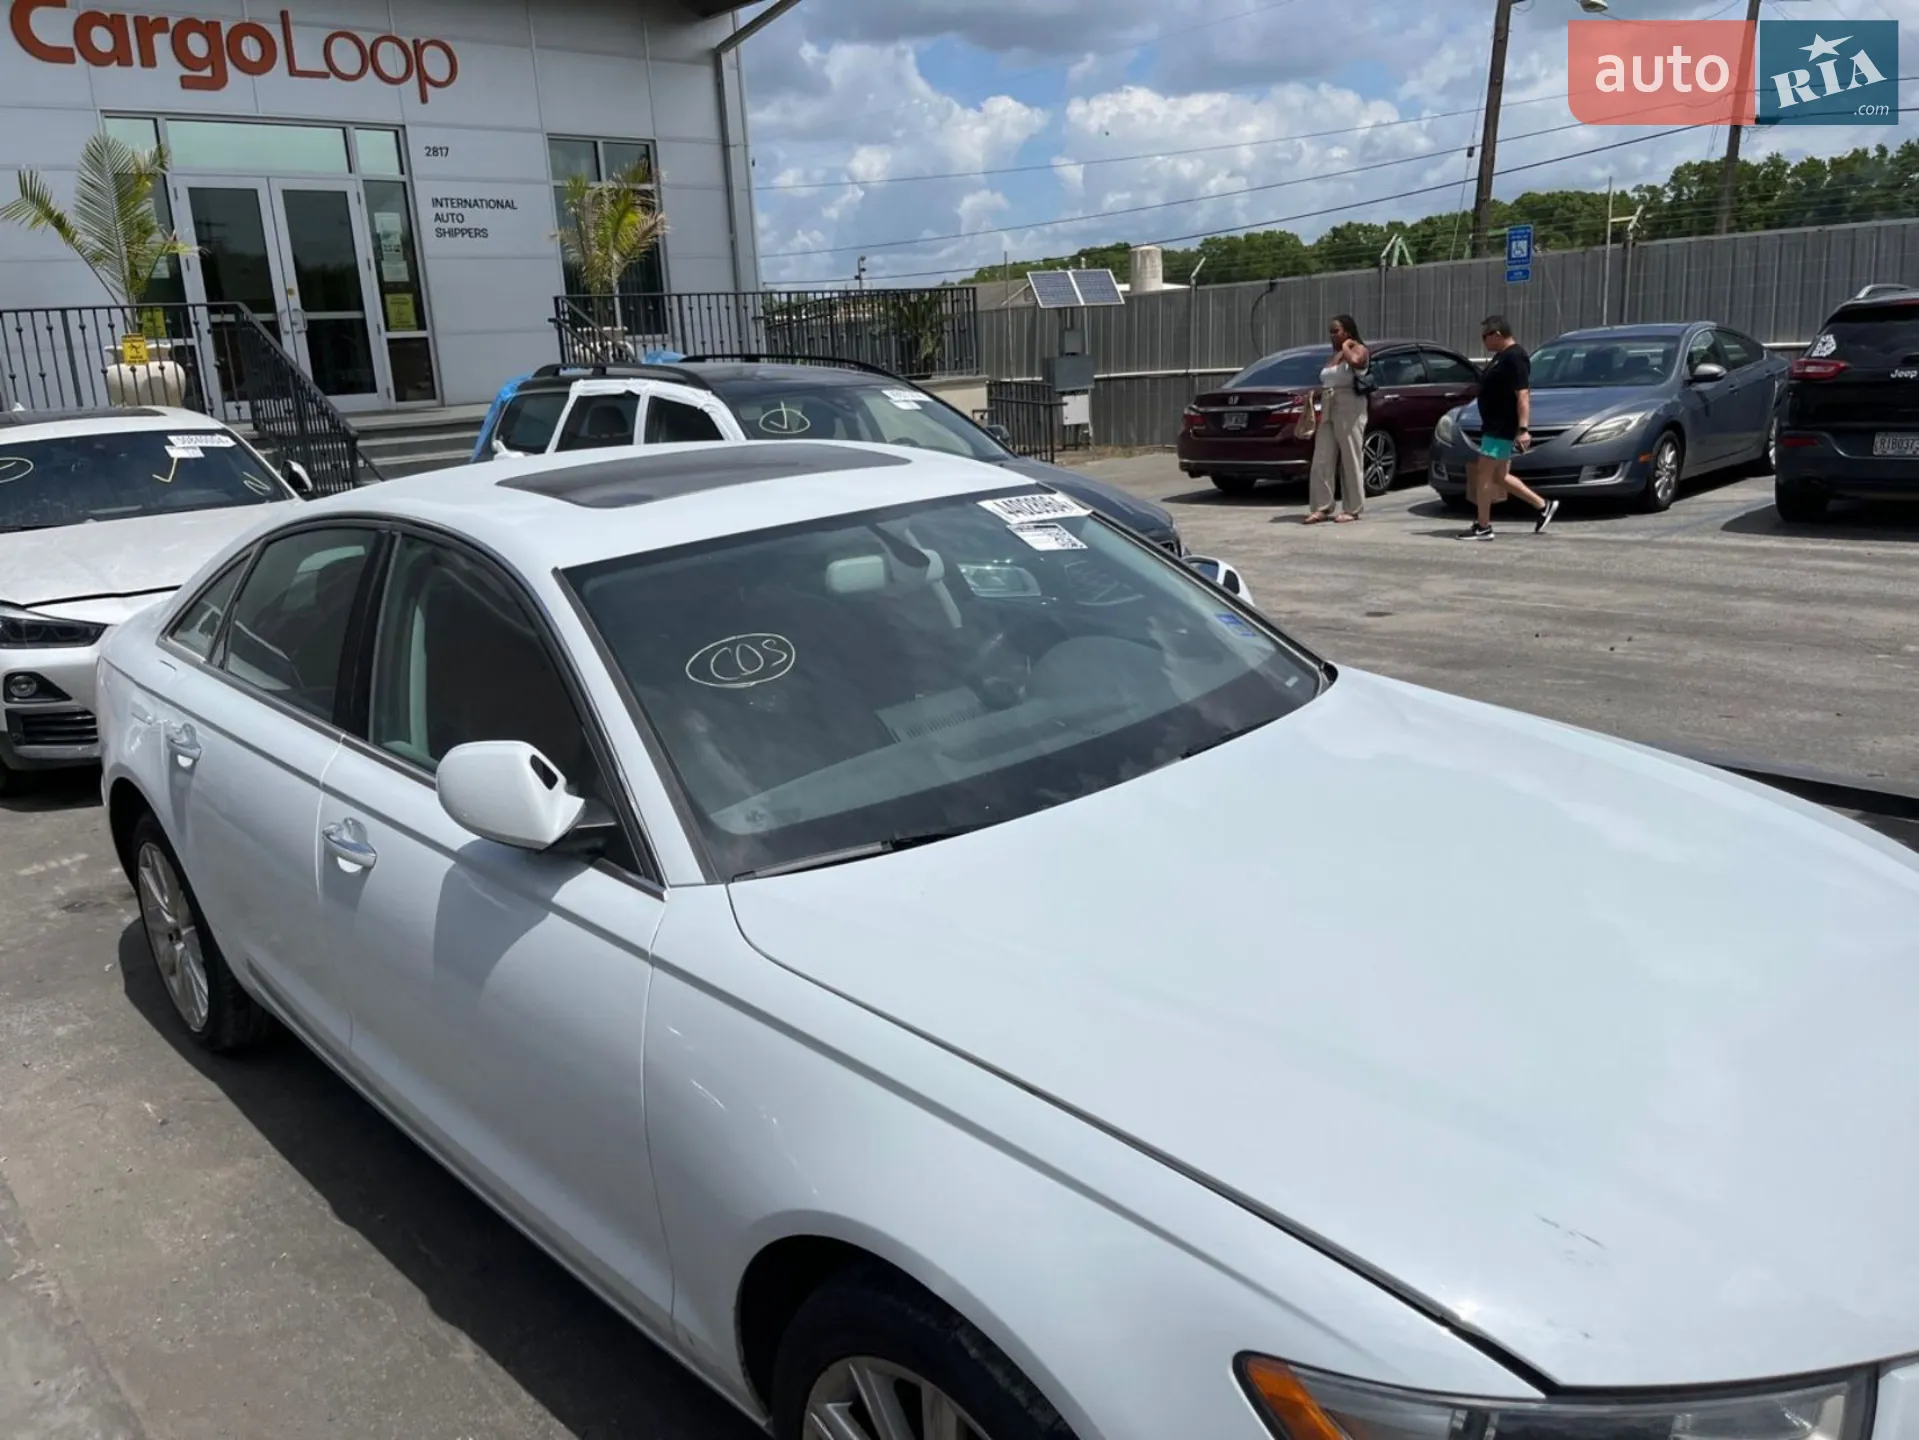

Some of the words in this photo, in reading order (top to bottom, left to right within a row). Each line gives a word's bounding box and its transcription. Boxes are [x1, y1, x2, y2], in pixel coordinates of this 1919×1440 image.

[424, 146, 449, 157] 2817
[431, 197, 519, 210] INTERNATIONAL
[433, 212, 465, 223] AUTO
[435, 227, 489, 238] SHIPPERS
[1890, 369, 1918, 379] Jeep
